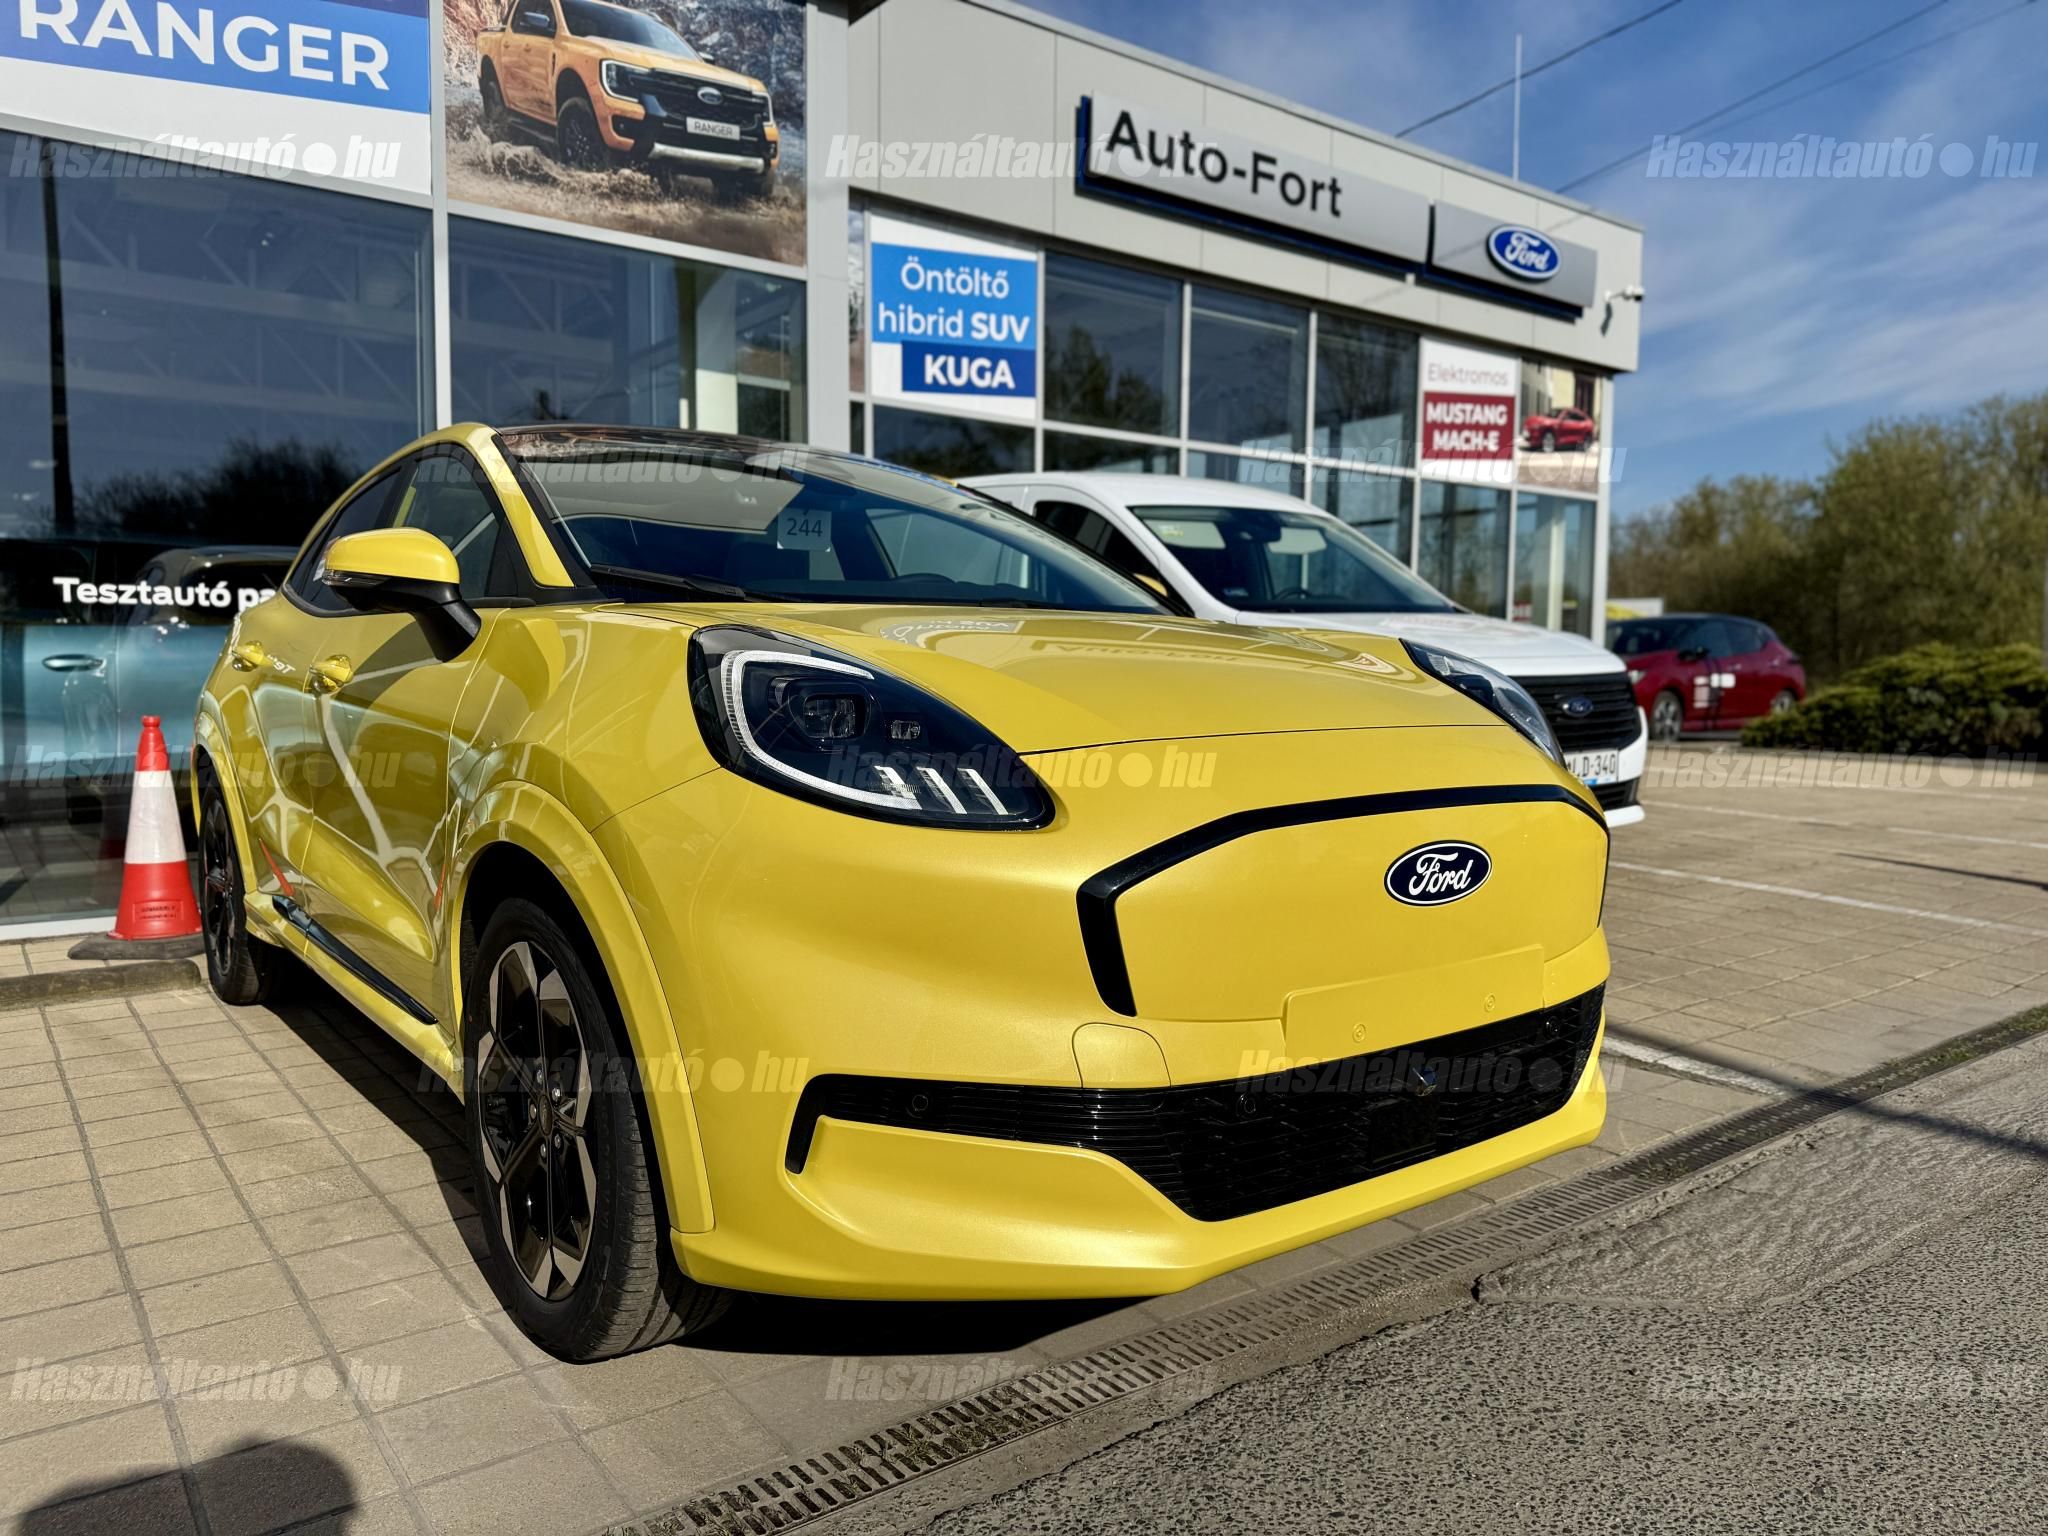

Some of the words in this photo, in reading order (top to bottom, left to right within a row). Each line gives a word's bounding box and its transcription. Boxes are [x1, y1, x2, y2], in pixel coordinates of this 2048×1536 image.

[19, 0, 390, 91] RANGER
[693, 121, 733, 137] RANGER
[1105, 110, 1342, 218] Auto-Fort
[1504, 231, 1551, 271] Ford
[901, 255, 1010, 299] Öntöltő
[878, 302, 963, 338] hibrid
[970, 311, 1030, 343] SUV
[924, 353, 1016, 390] KUGA
[1427, 363, 1509, 387] Elektromos
[1425, 402, 1508, 426] MUSTANG
[1432, 429, 1500, 453] MACH-E
[786, 518, 824, 538] 244
[53, 576, 231, 608] Tesztautó
[1408, 852, 1474, 896] Ford
